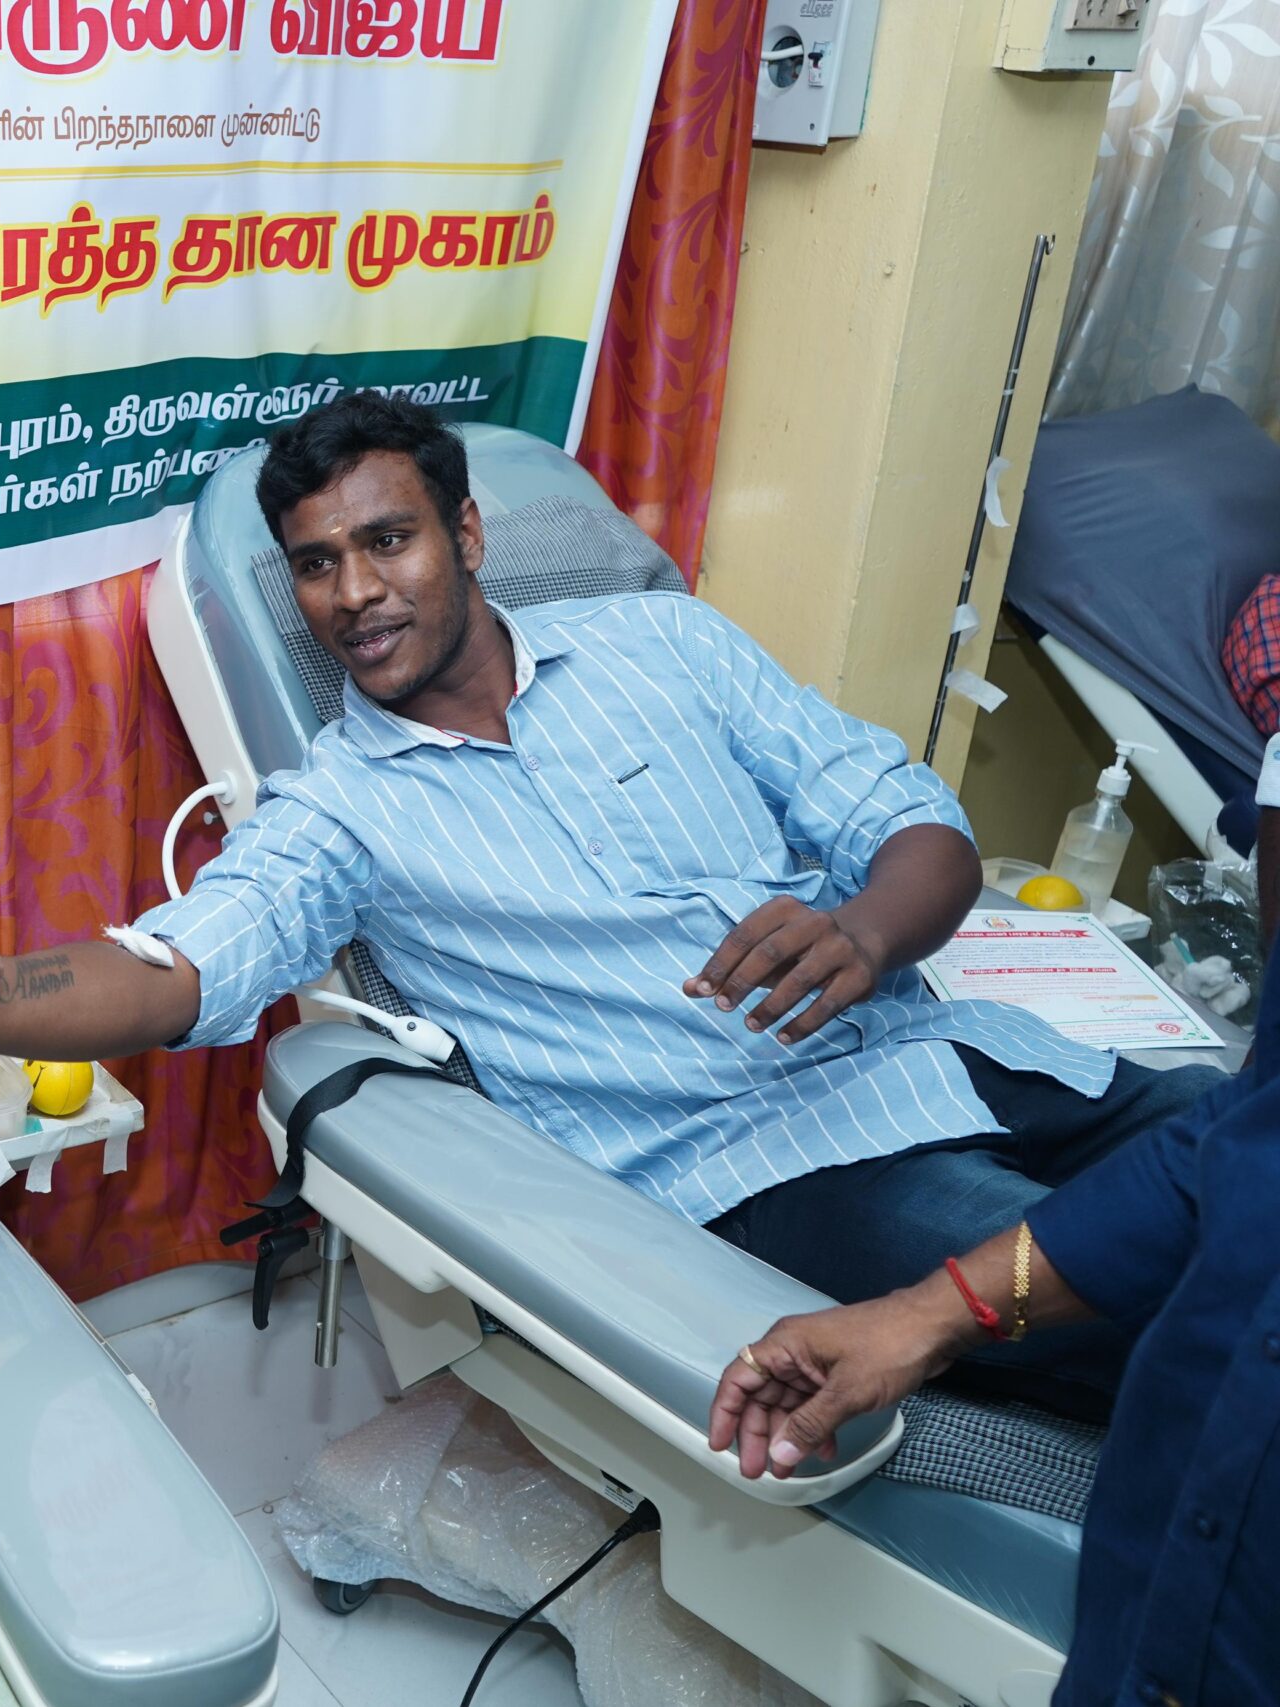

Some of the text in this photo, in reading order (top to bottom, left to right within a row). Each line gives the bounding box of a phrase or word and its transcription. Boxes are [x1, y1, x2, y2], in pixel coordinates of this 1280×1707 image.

[53, 104, 216, 151] பிறந்தநாளை
[221, 103, 320, 147] முன்னிட்டு
[166, 215, 337, 299] தான
[348, 194, 555, 288] முகாம்
